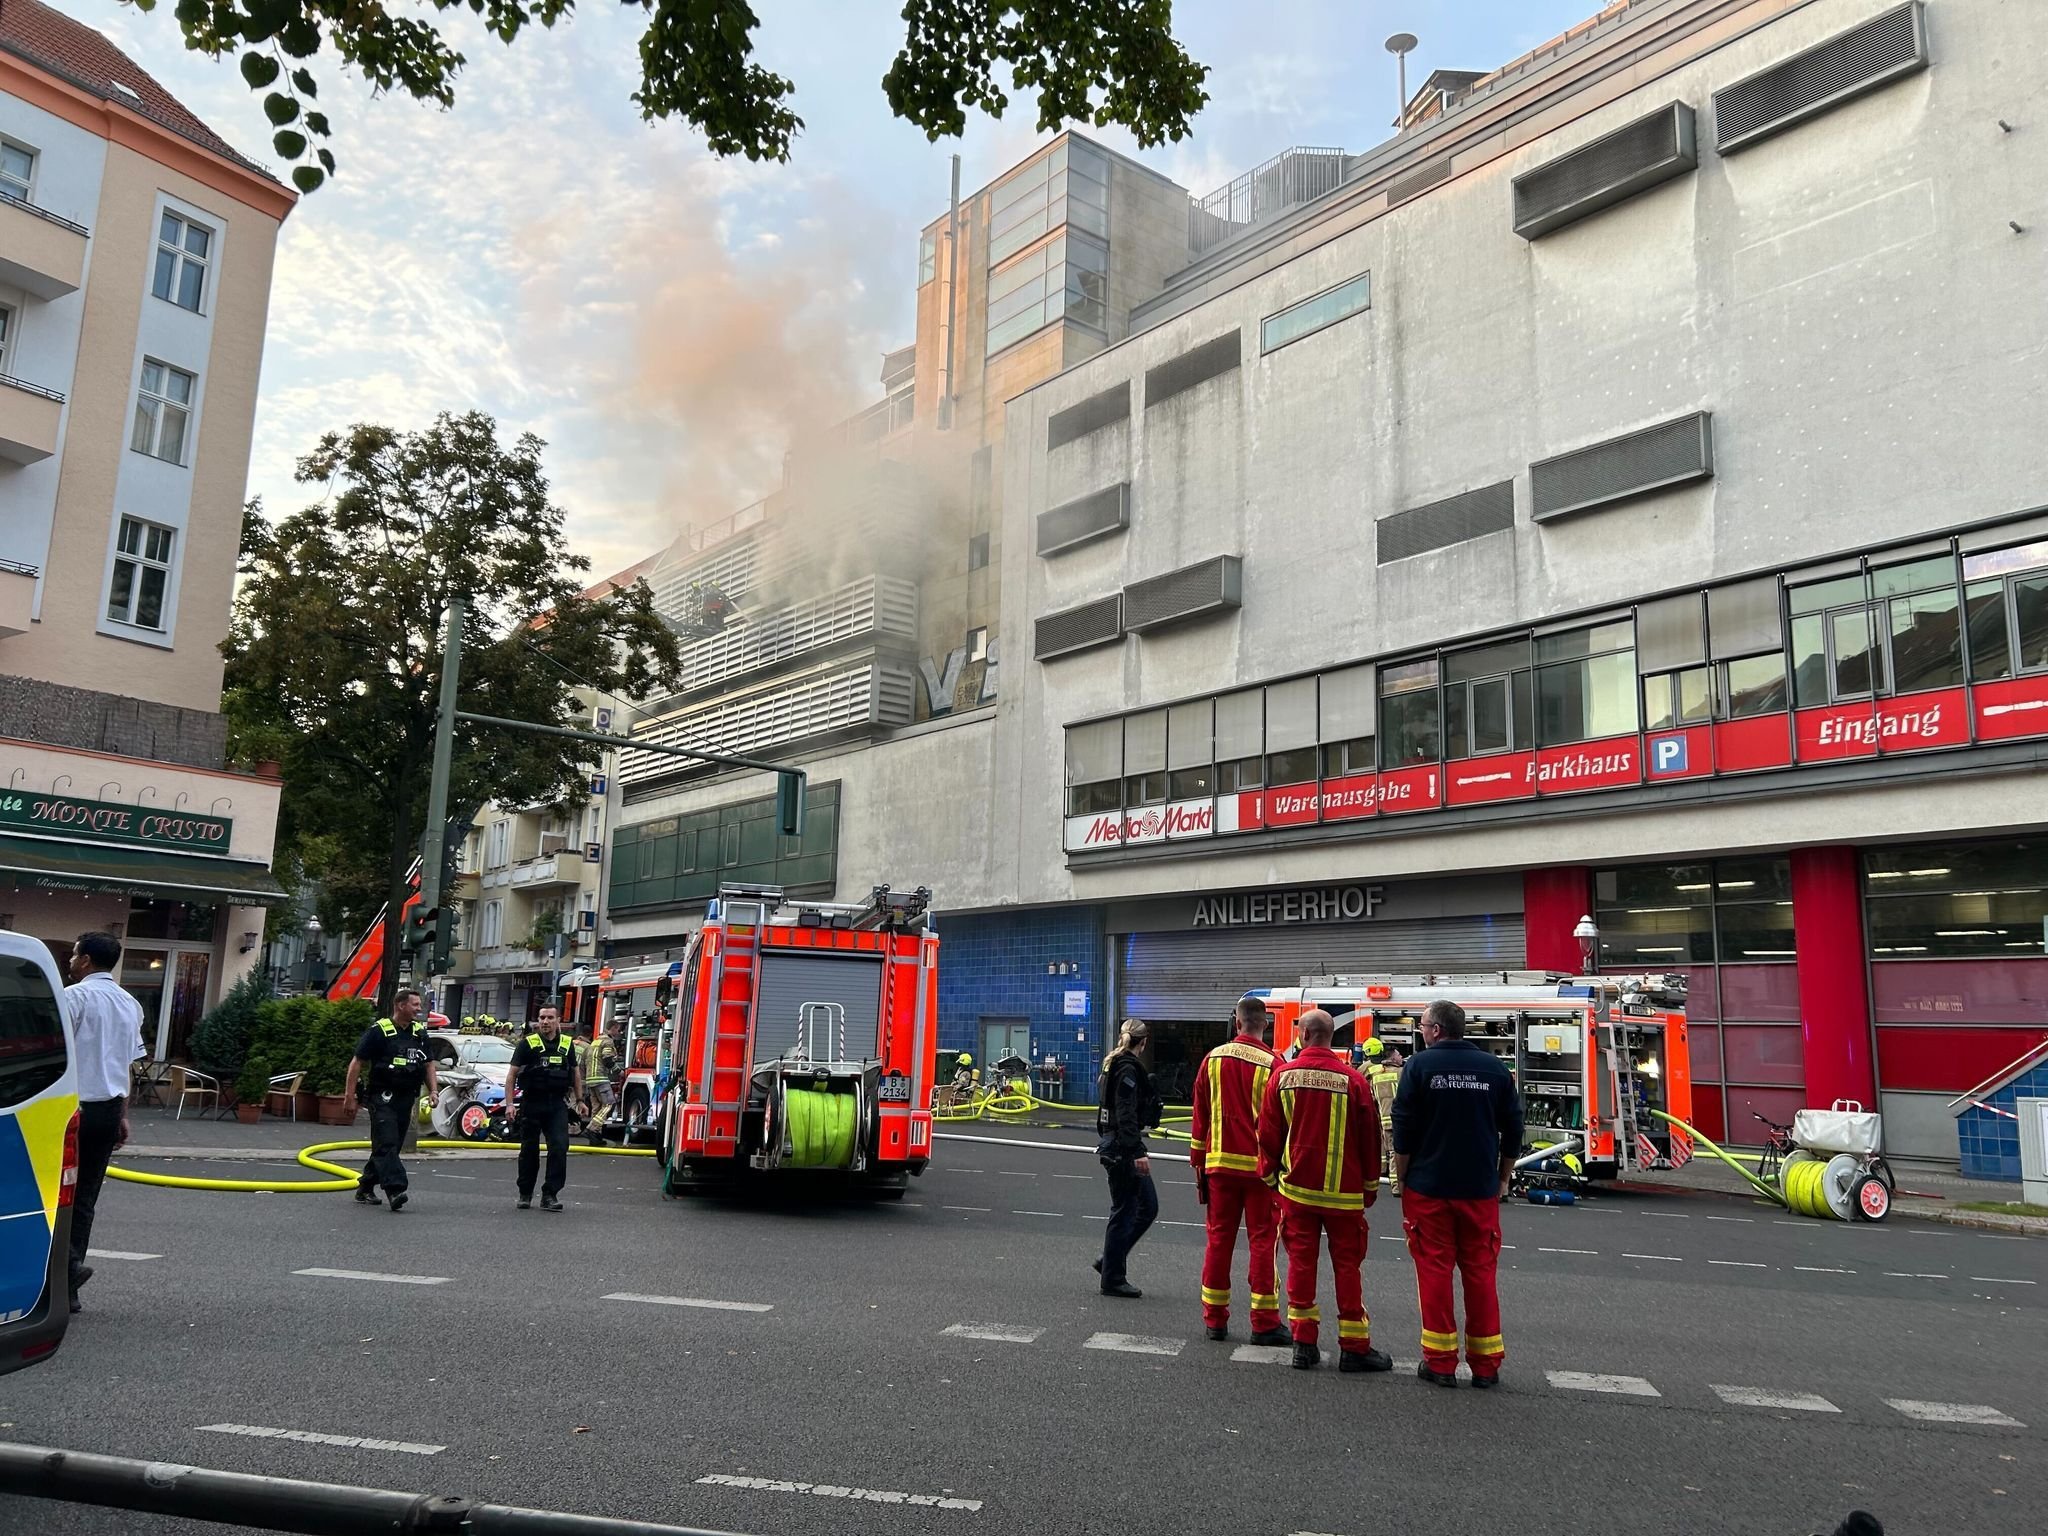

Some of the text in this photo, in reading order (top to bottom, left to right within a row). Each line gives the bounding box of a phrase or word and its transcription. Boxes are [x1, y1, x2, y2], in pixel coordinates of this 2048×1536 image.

[1819, 704, 1941, 745] Eingang
[1525, 753, 1631, 782] Parkhaus
[1658, 741, 1680, 769] P
[1276, 781, 1411, 814] Warenausgabe
[0, 796, 224, 840] te MONTE CRISTO
[1084, 805, 1214, 844] Media Markt
[1192, 886, 1384, 926] ANLIEFERHOF
[891, 1078, 898, 1087] B
[1303, 1078, 1346, 1089] FEUERWEHR
[1448, 1074, 1477, 1082] BERLINER
[1448, 1081, 1490, 1091] FEUERWEHR
[883, 1088, 906, 1098] 2134
